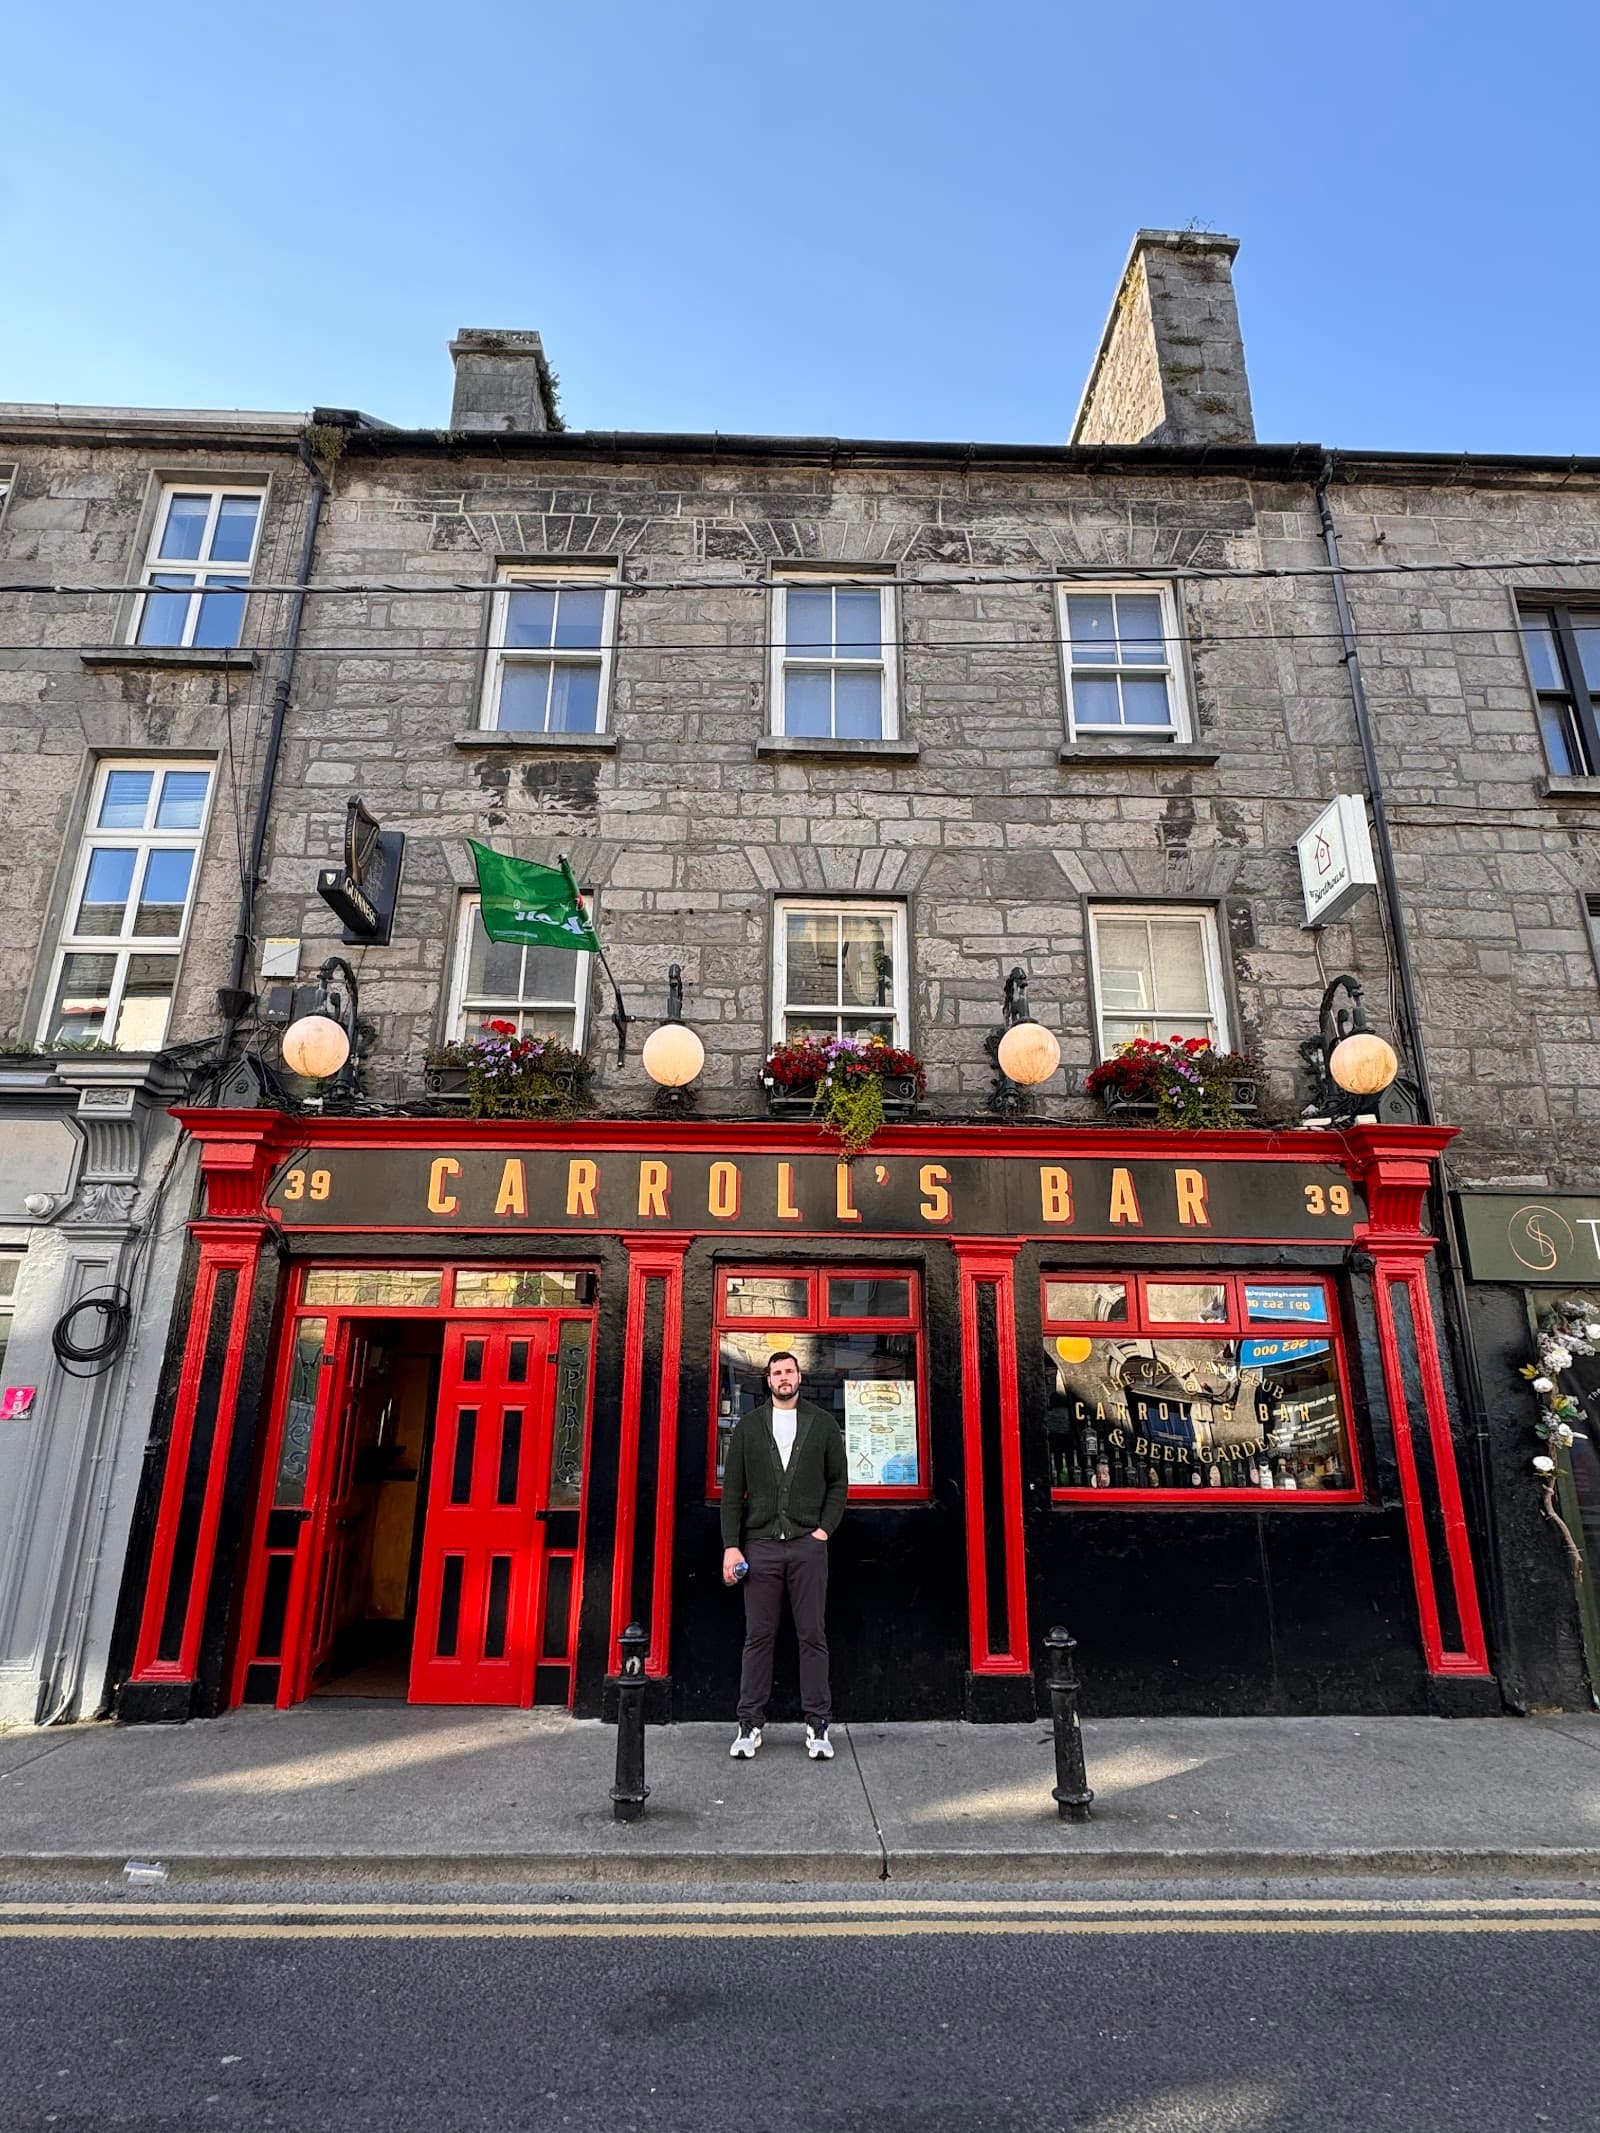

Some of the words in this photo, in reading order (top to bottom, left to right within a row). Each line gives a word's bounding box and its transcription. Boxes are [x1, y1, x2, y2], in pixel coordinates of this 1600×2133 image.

[345, 876, 376, 927] GUINNESS
[284, 1169, 331, 1200] 39
[427, 1157, 952, 1224] CARROLL'S
[1040, 1166, 1212, 1228] BAR
[1304, 1184, 1350, 1216] 39
[1098, 1371, 1136, 1396] THE
[1141, 1359, 1229, 1379] CARAVAN
[1238, 1367, 1284, 1399] CLUB
[1184, 1379, 1198, 1395] @
[1258, 1402, 1311, 1423] BAR
[1108, 1428, 1126, 1449] &
[1135, 1436, 1191, 1465] BEER
[1199, 1432, 1283, 1464] GARDEN
